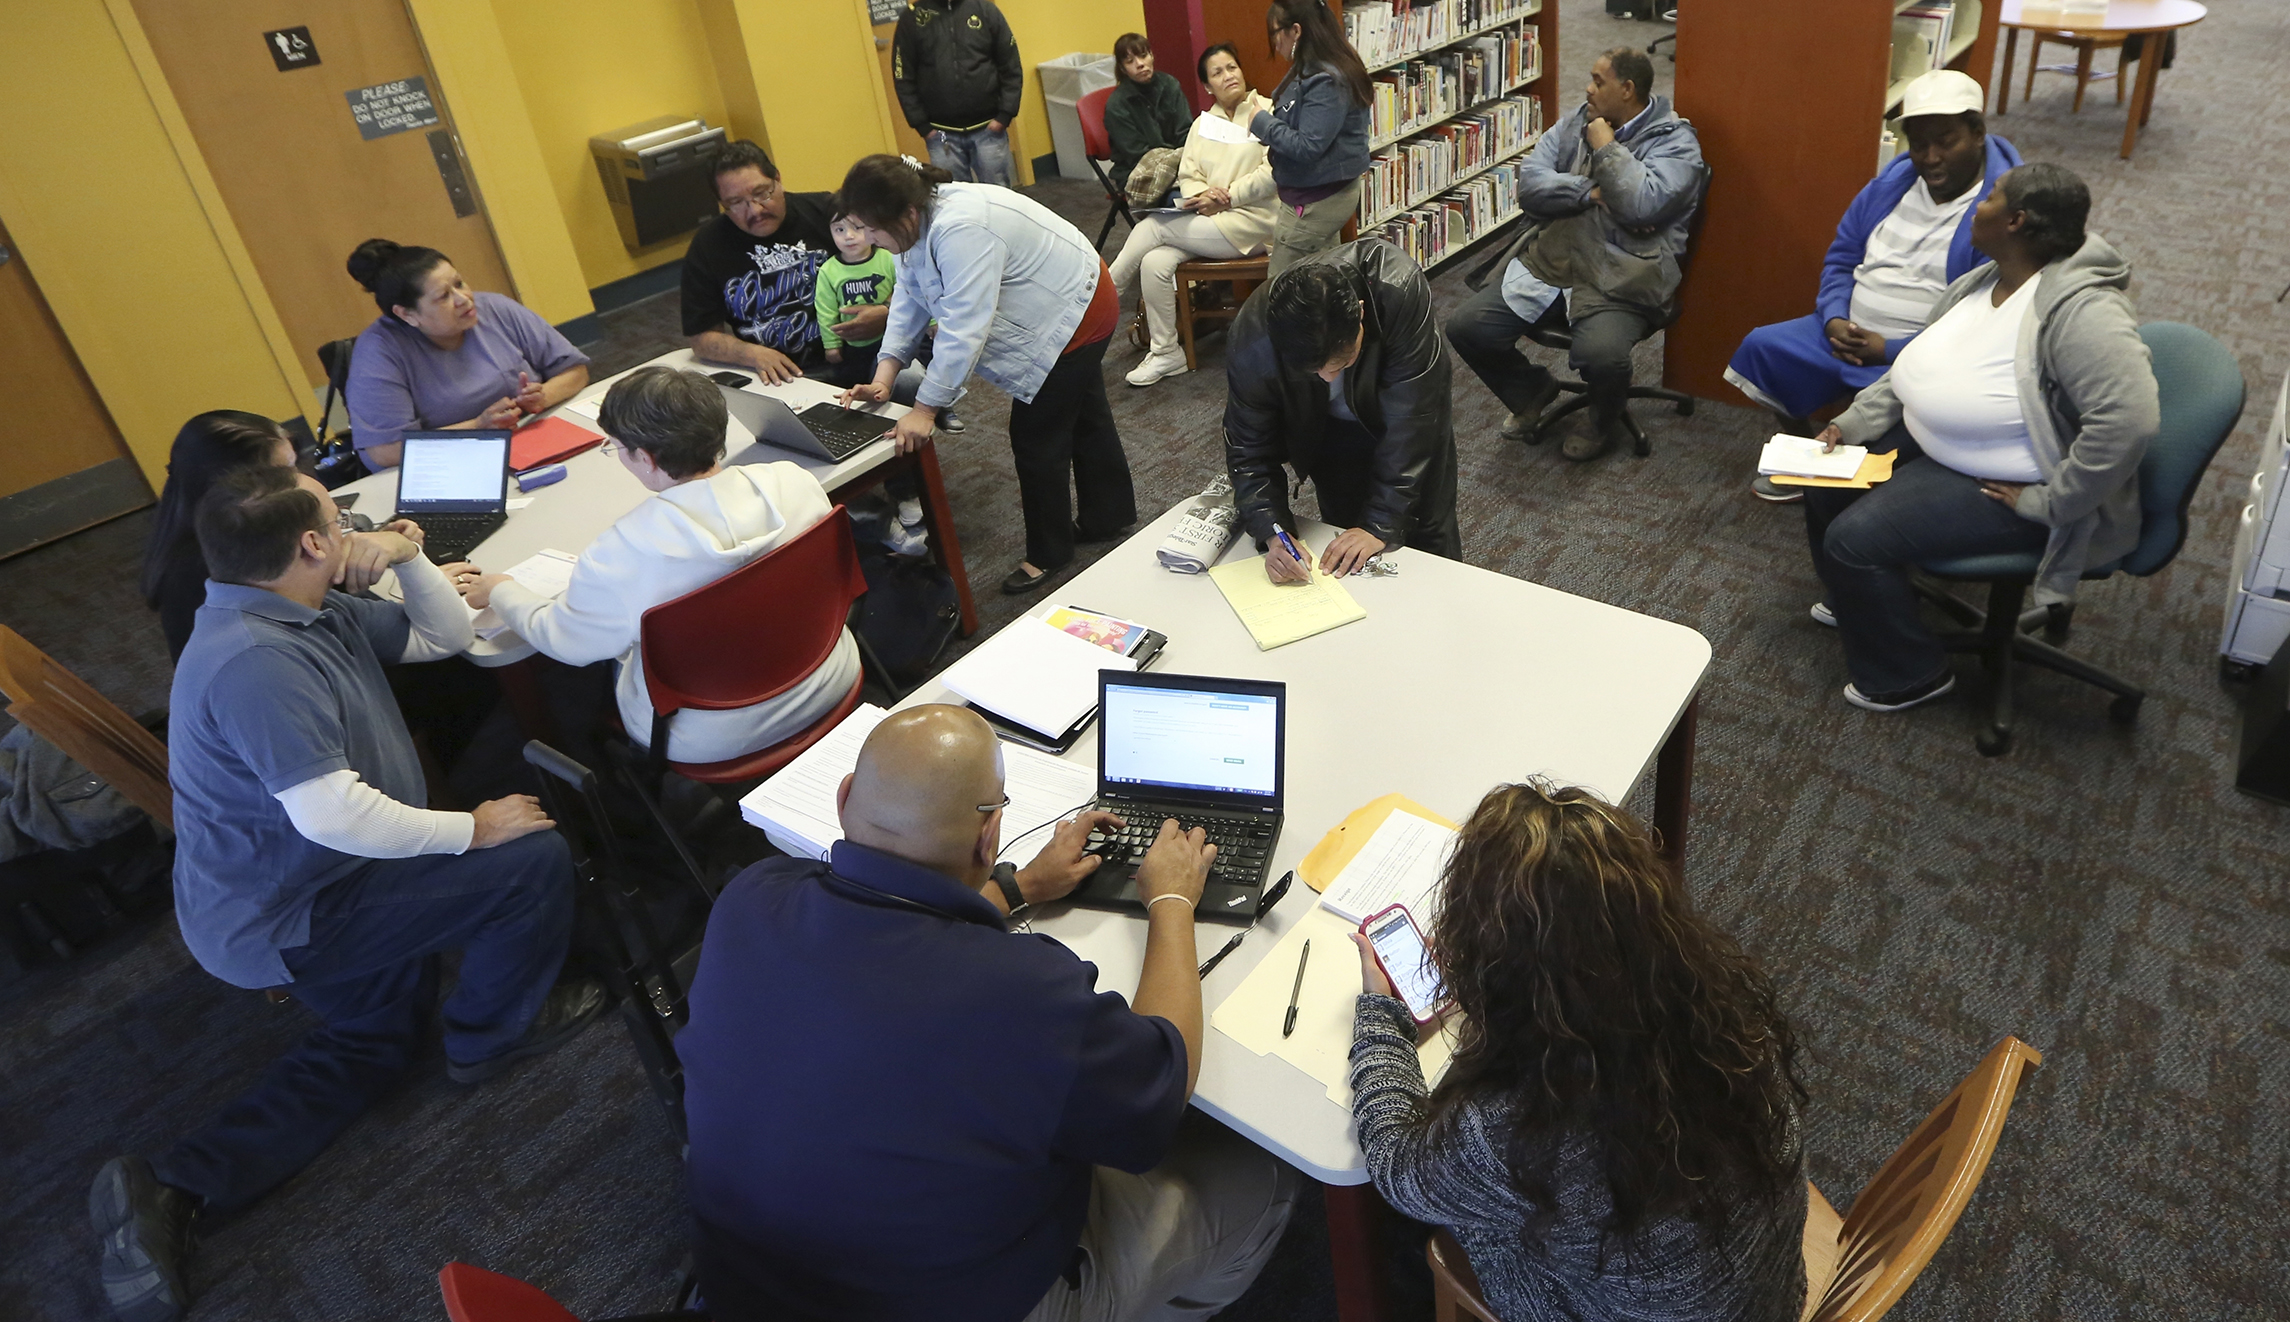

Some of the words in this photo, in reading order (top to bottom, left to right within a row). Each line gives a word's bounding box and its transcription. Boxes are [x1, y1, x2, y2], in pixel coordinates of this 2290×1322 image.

[286, 51, 307, 61] MEN
[352, 103, 369, 114] DO
[369, 98, 390, 110] NOT
[392, 90, 426, 105] KNOCK
[356, 112, 372, 124] ON
[373, 106, 402, 119] DOOR
[402, 99, 432, 112] WHEN
[845, 280, 873, 294] HUNK
[1179, 527, 1214, 543] FIRST
